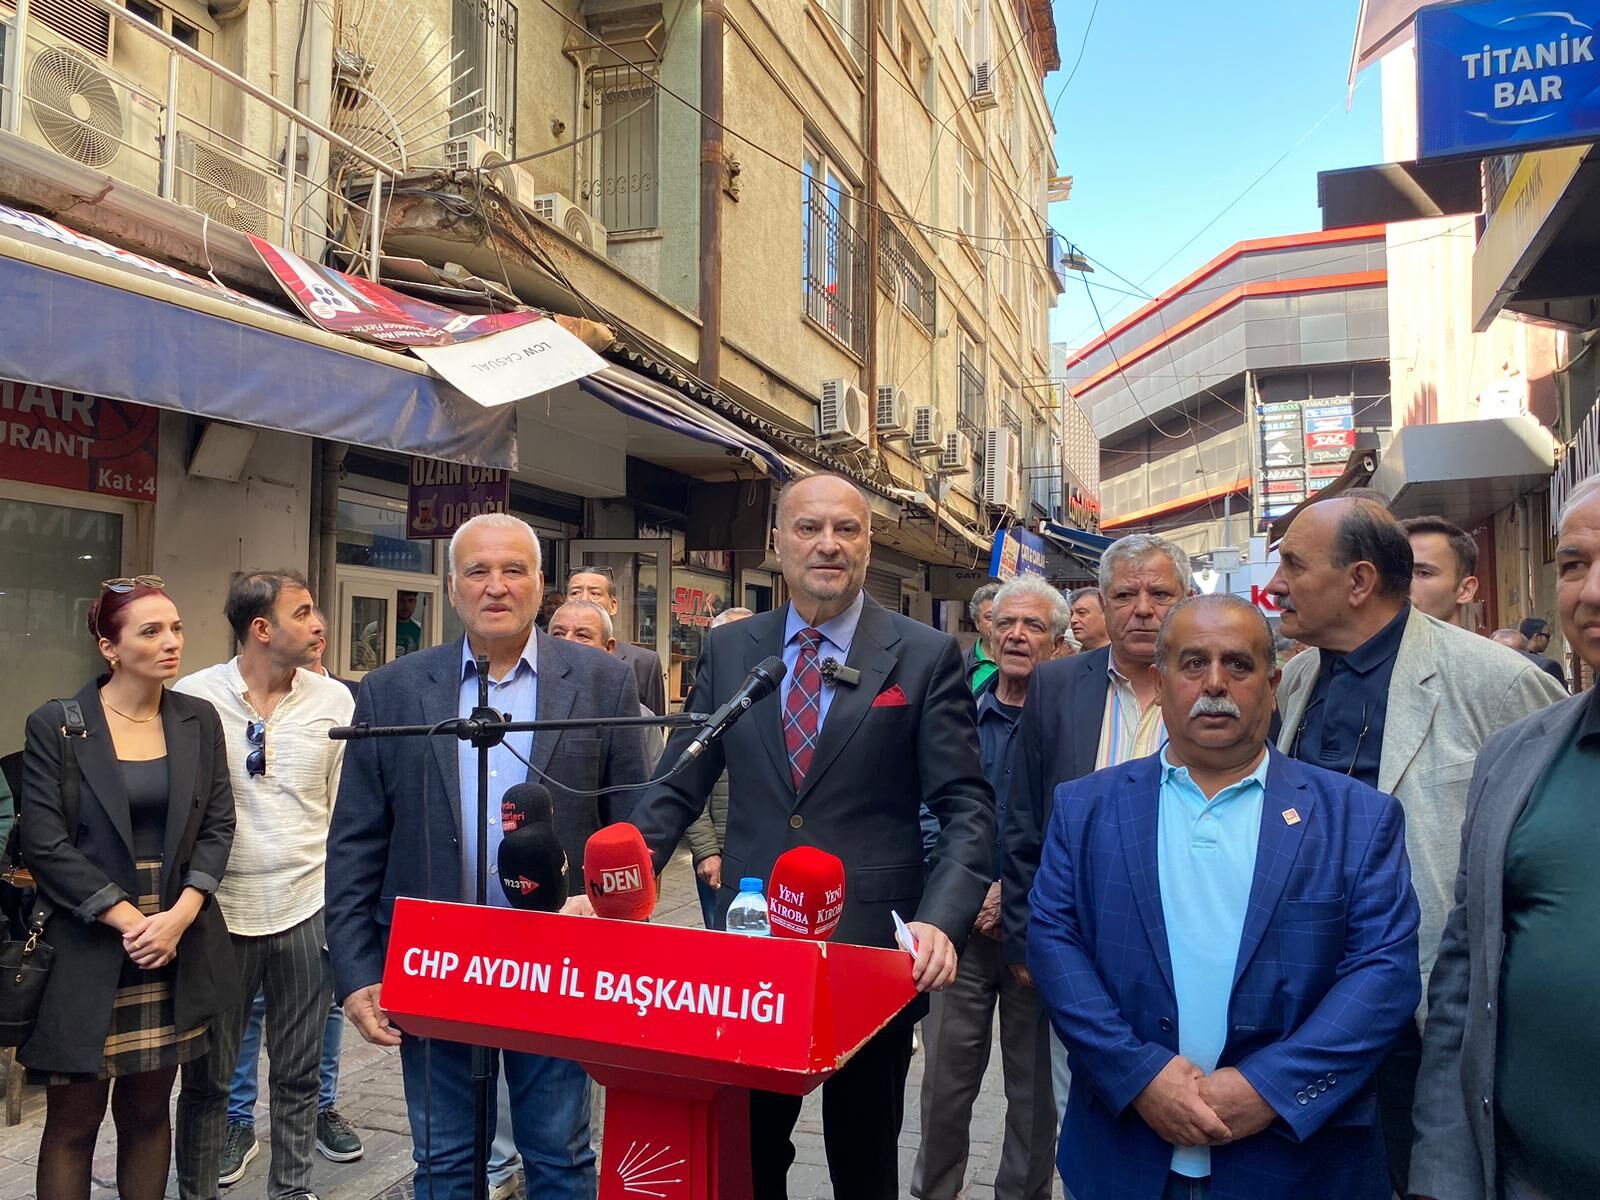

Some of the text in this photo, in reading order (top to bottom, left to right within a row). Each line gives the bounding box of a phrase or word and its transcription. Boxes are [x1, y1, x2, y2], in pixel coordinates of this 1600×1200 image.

[1461, 33, 1595, 80] TİTANİK
[1494, 75, 1563, 110] BAR
[1513, 157, 1544, 230] TİTANİK
[471, 341, 552, 373] LCW CASUAL
[98, 467, 156, 495] Kat :4
[1260, 469, 1300, 481] KARACA
[770, 897, 809, 925] KIROBA
[779, 884, 805, 907] YENİ
[402, 947, 785, 1025] CHP AYDIN İL BAŞKANLIĞI
